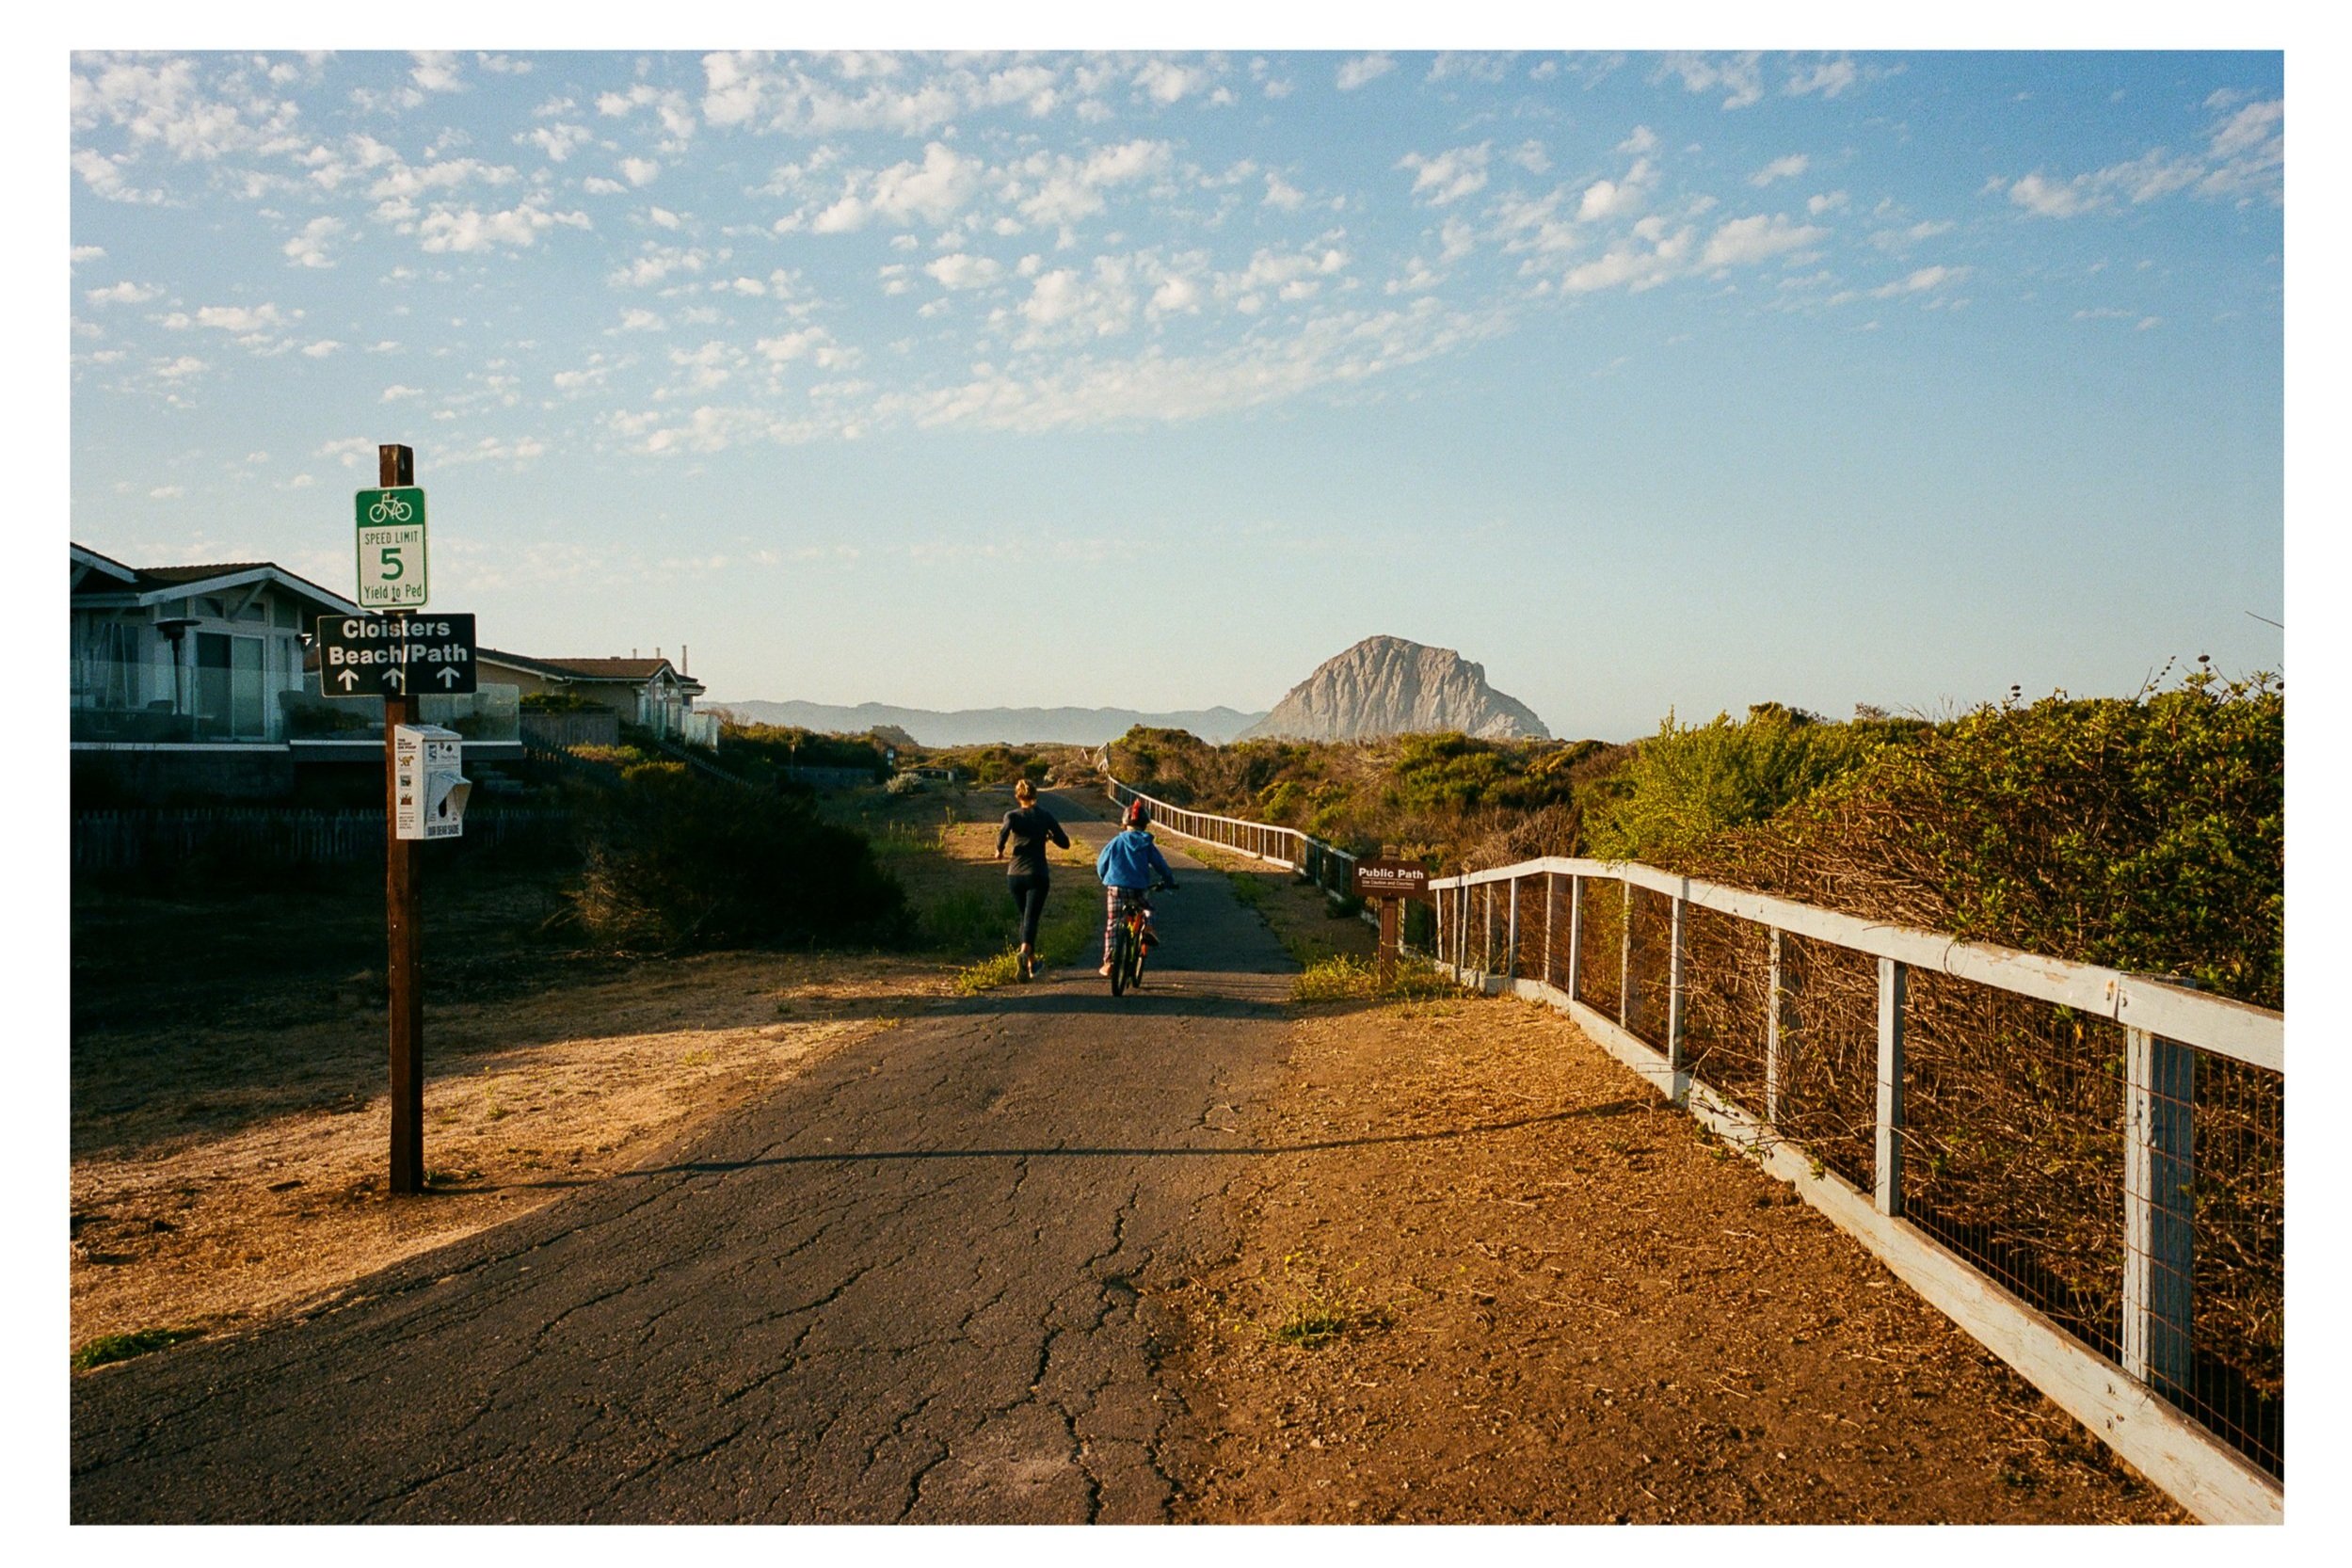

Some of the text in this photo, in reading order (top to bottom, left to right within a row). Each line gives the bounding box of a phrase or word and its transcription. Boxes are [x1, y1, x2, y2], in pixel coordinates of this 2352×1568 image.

[365, 531, 419, 545] SPEED LIMIT
[381, 548, 404, 580] 5
[364, 584, 422, 600] Yield to Ped
[343, 619, 451, 638] Cloisters
[1358, 868, 1424, 879] Public Path
